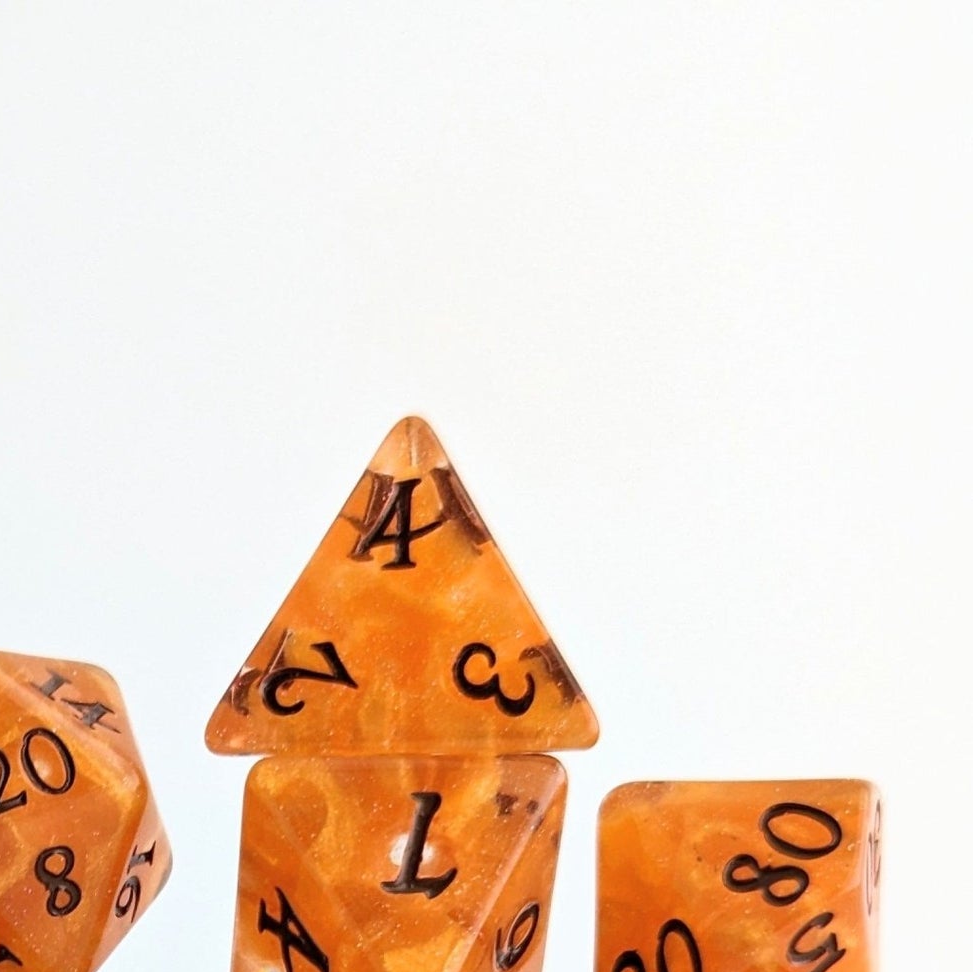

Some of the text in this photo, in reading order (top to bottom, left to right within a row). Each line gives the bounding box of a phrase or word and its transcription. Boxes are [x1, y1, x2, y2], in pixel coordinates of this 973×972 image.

[355, 477, 443, 570] 4
[32, 669, 121, 735] 14
[260, 641, 359, 716] 2
[452, 642, 535, 716] 3
[34, 845, 81, 916] 8
[722, 802, 842, 906] 80
